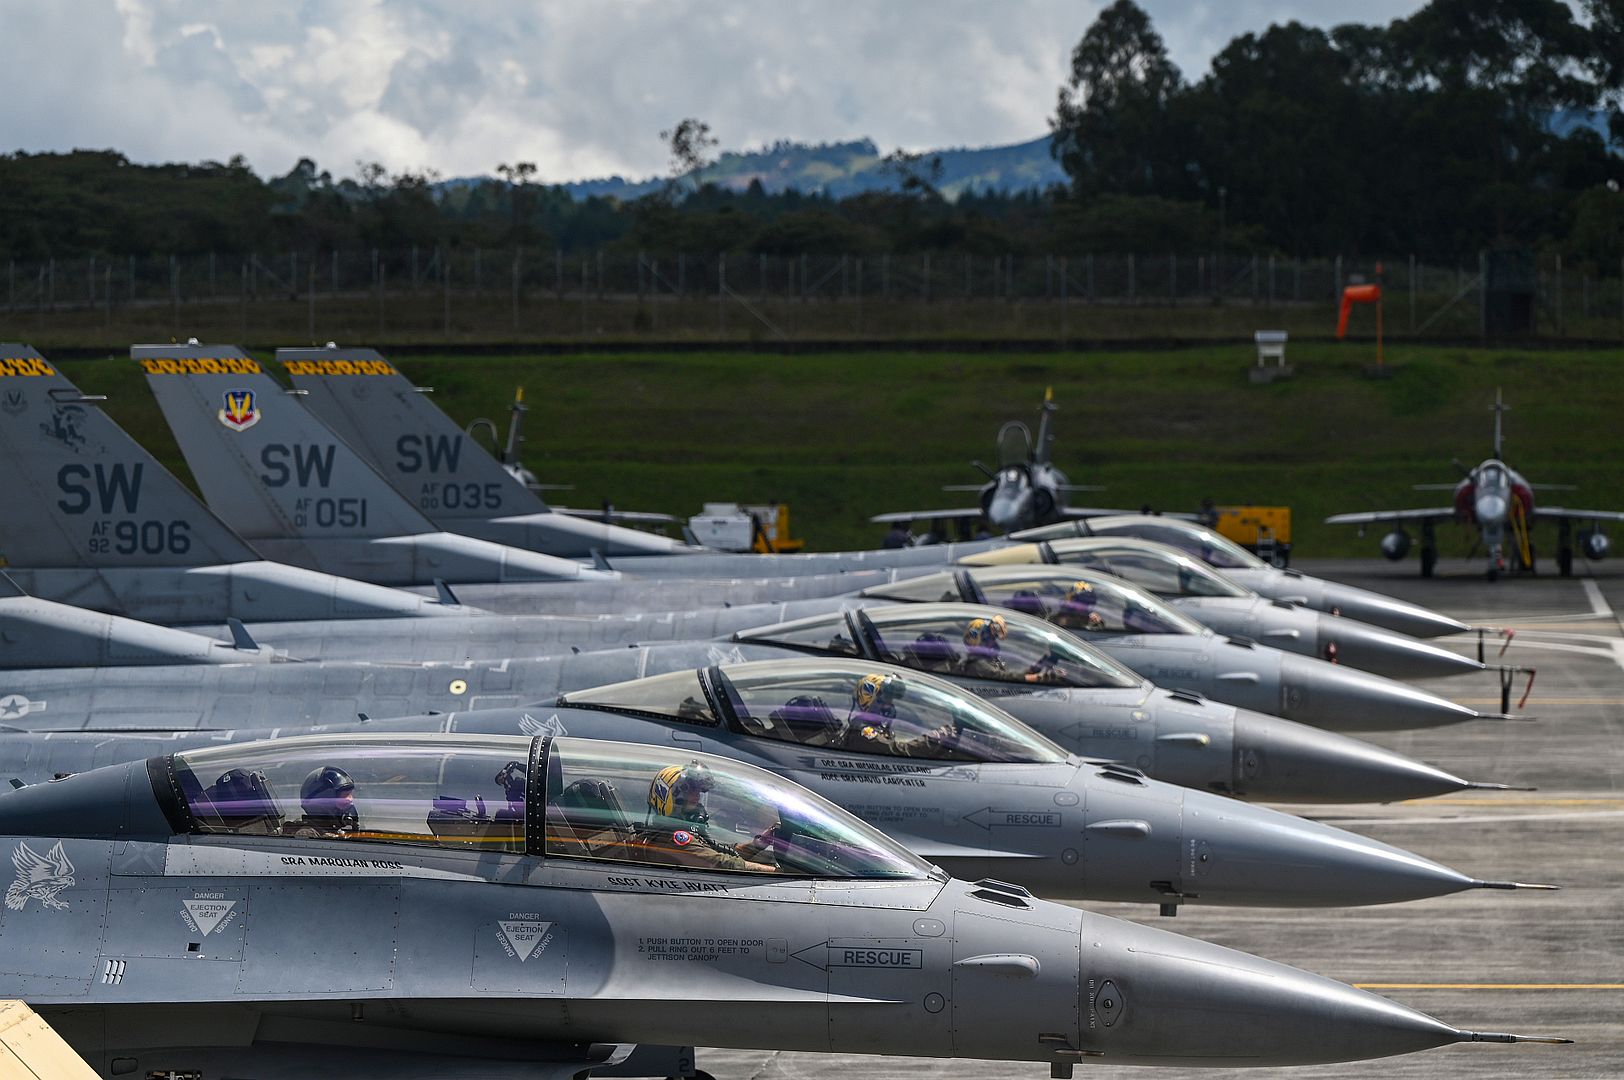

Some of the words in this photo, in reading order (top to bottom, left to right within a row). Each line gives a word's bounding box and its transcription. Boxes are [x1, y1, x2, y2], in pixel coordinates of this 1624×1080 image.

[396, 434, 463, 473] SW
[261, 443, 336, 488] SW
[57, 463, 144, 514] SW
[421, 483, 439, 495] AF
[442, 483, 502, 509] 035
[295, 498, 312, 511] AF
[316, 498, 367, 528] 051
[92, 521, 111, 536] AF
[89, 538, 110, 553] 92
[115, 520, 191, 555] 906
[892, 764, 932, 774] FREELAND
[857, 775, 881, 784] DAVID
[882, 777, 926, 788] CARPENTER
[1006, 814, 1054, 825] RESCUE
[280, 856, 306, 866] SRA
[308, 857, 369, 868] MARQUAN
[371, 860, 404, 870] ROSS
[607, 876, 641, 887] SSGT
[644, 879, 682, 890] KYLE
[683, 881, 729, 893] HYATT
[194, 892, 225, 900] DANGER
[214, 910, 237, 934] DANGER
[509, 912, 540, 920] DANGER
[505, 925, 543, 933] EJECTION
[495, 931, 515, 957] DANGER
[514, 933, 535, 941] SEAT
[670, 938, 701, 946] BUTTON
[531, 933, 554, 959] DANGER
[690, 946, 707, 954] OUT
[647, 953, 685, 961] JETTISON
[843, 950, 912, 965] RESCUE
[678, 1058, 690, 1072] 2
